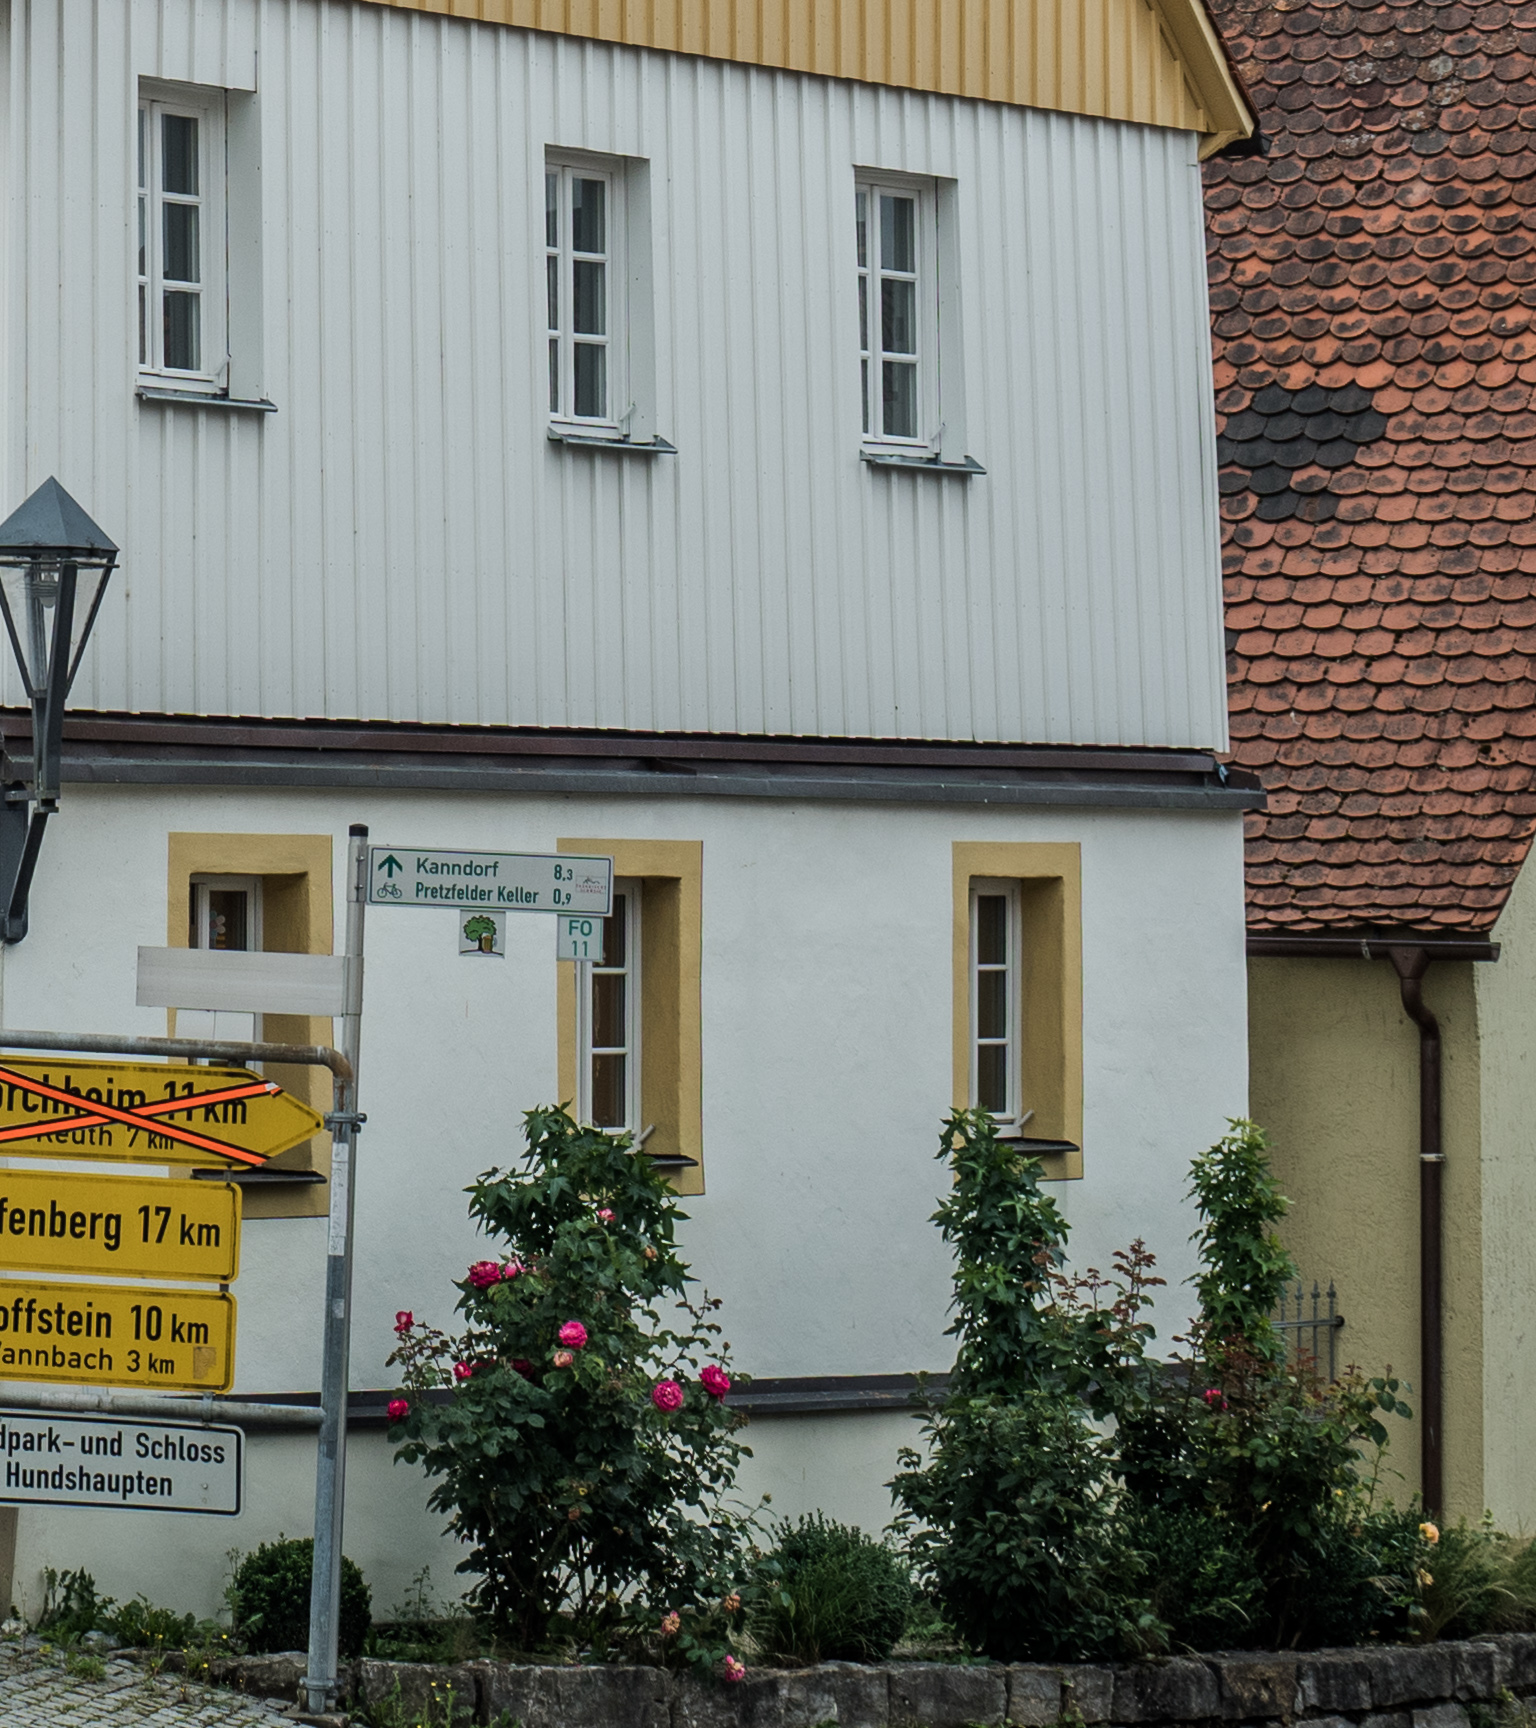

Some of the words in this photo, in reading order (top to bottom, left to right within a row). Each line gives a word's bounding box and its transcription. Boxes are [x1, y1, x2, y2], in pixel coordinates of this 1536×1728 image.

[416, 857, 499, 877] Kanndorf
[415, 881, 494, 902] Pretzfelder
[497, 885, 539, 904] Keller
[568, 919, 593, 937] FO
[571, 940, 589, 957] 11
[137, 1205, 172, 1244] 17
[179, 1214, 221, 1247] km
[130, 1304, 163, 1342] 10
[171, 1313, 209, 1344] km
[126, 1349, 141, 1373] 3
[148, 1352, 175, 1374] km
[135, 1432, 226, 1464] Schloss
[6, 1461, 173, 1500] Hundshaupten
